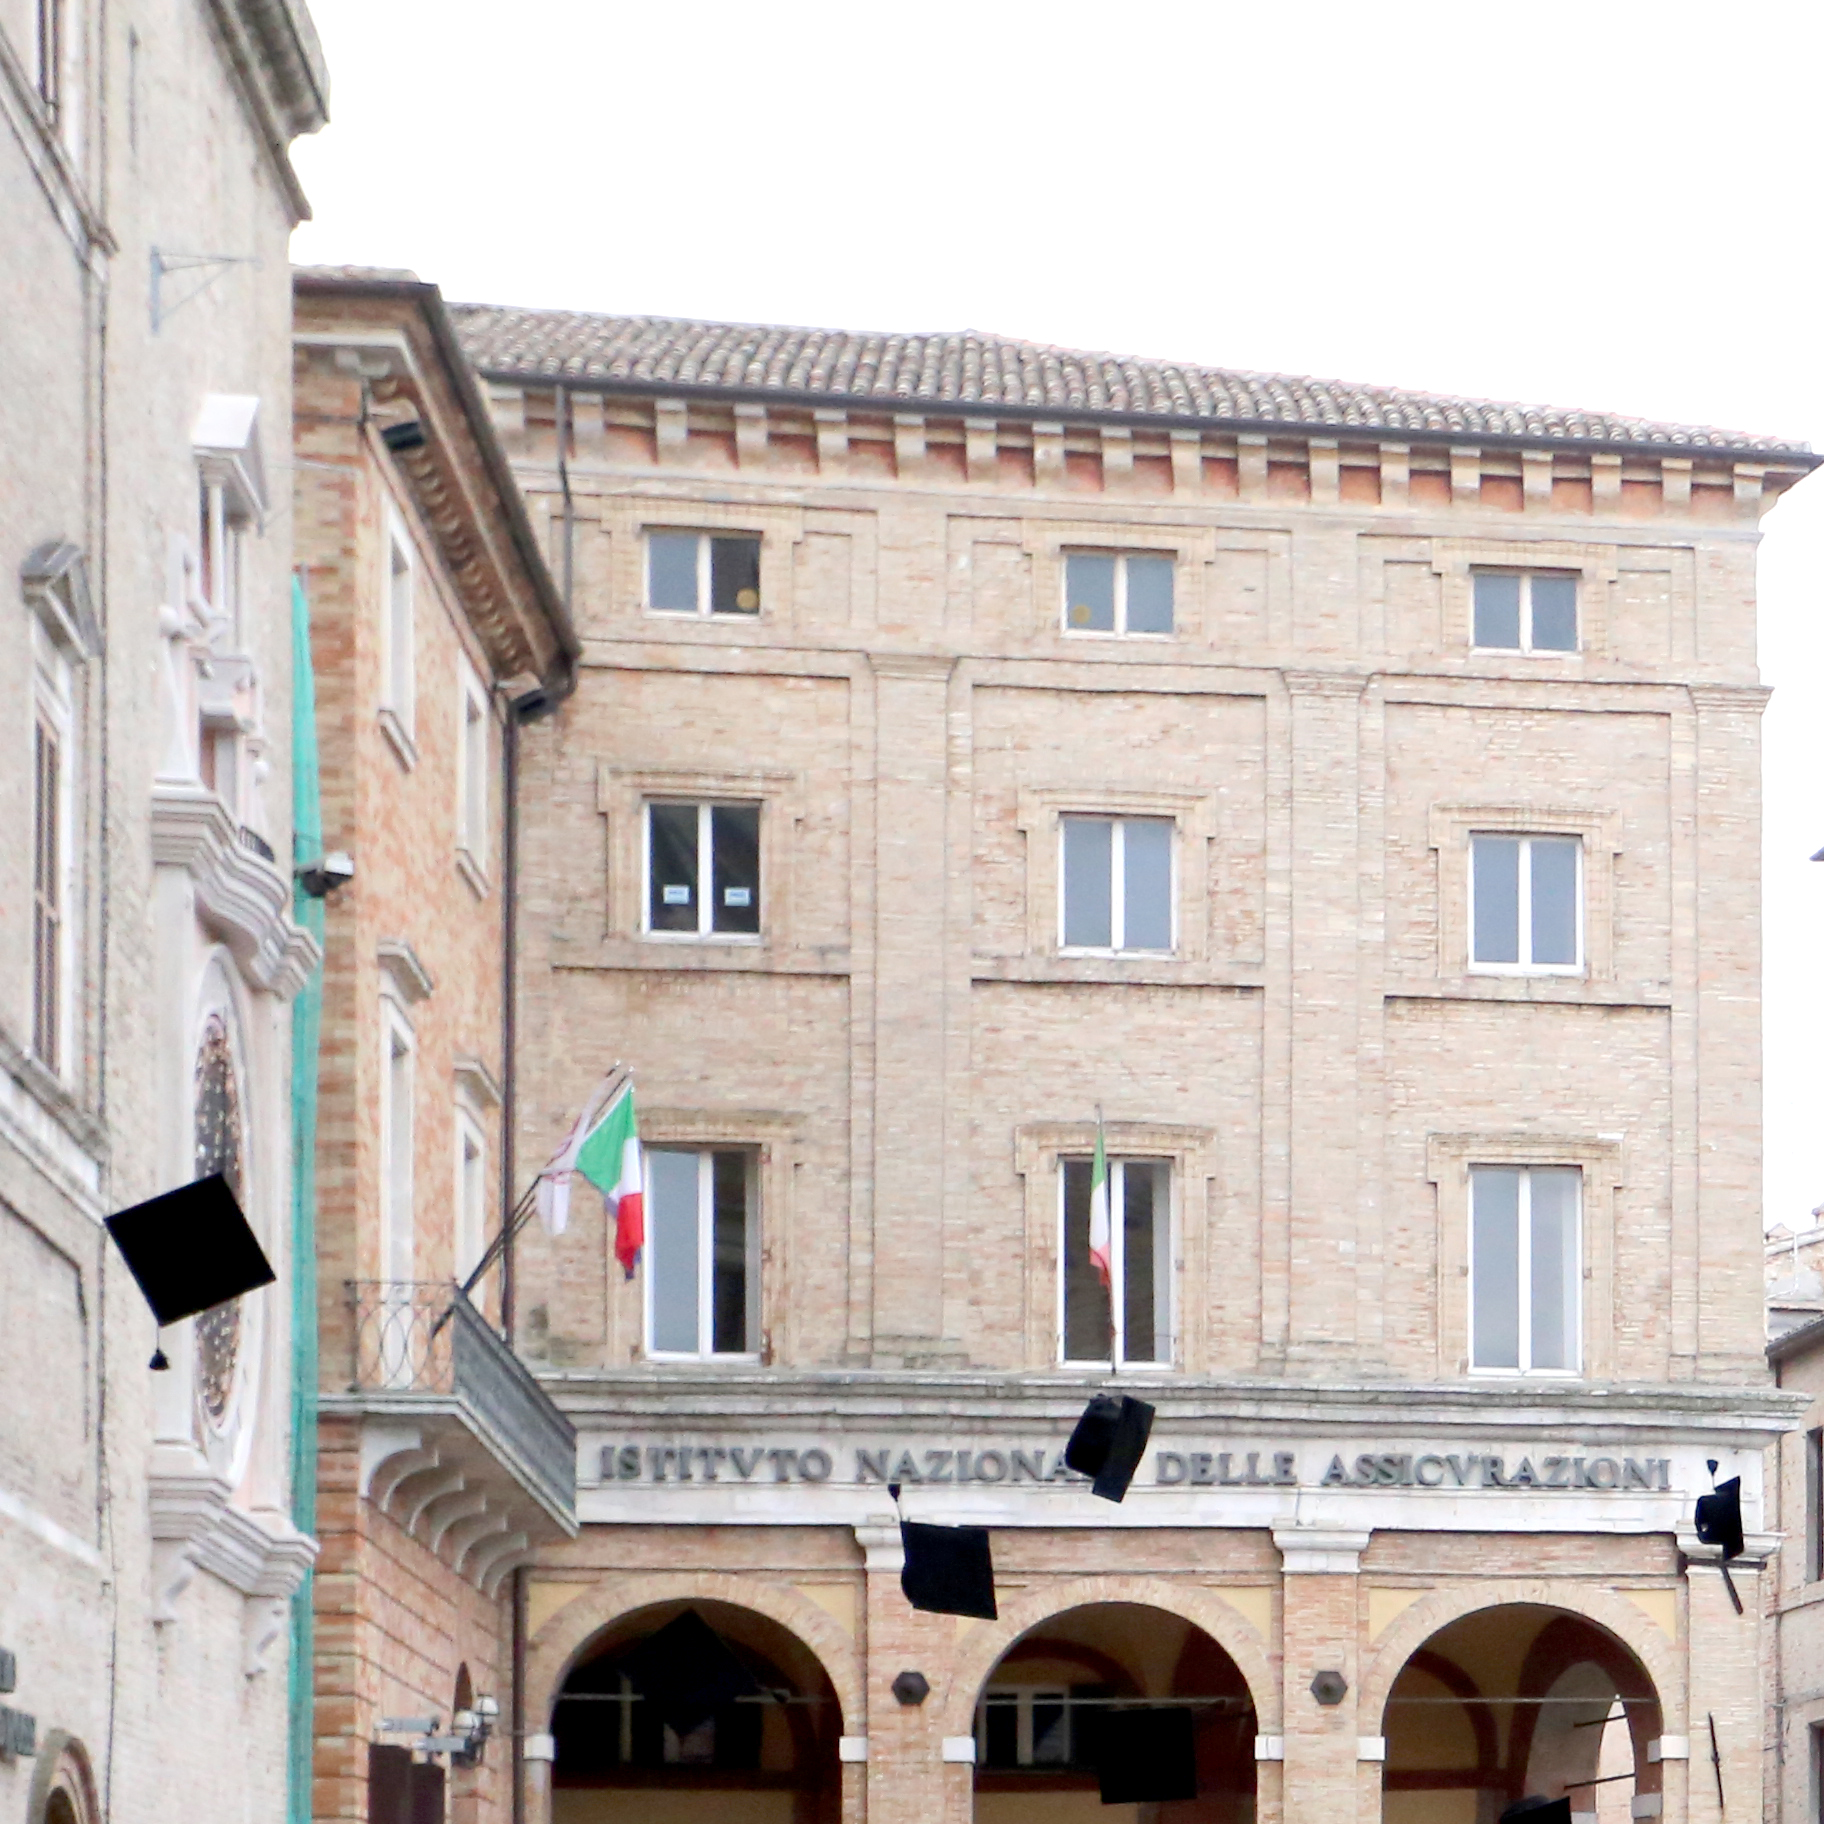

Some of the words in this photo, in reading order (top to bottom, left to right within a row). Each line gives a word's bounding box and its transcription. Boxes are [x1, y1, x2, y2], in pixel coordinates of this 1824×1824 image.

[599, 1445, 832, 1482] ISTITVTO
[855, 1447, 1094, 1483] NAZIONA
[1156, 1451, 1298, 1486] DELLE
[1321, 1453, 1672, 1491] ASSICVRAZIONI
